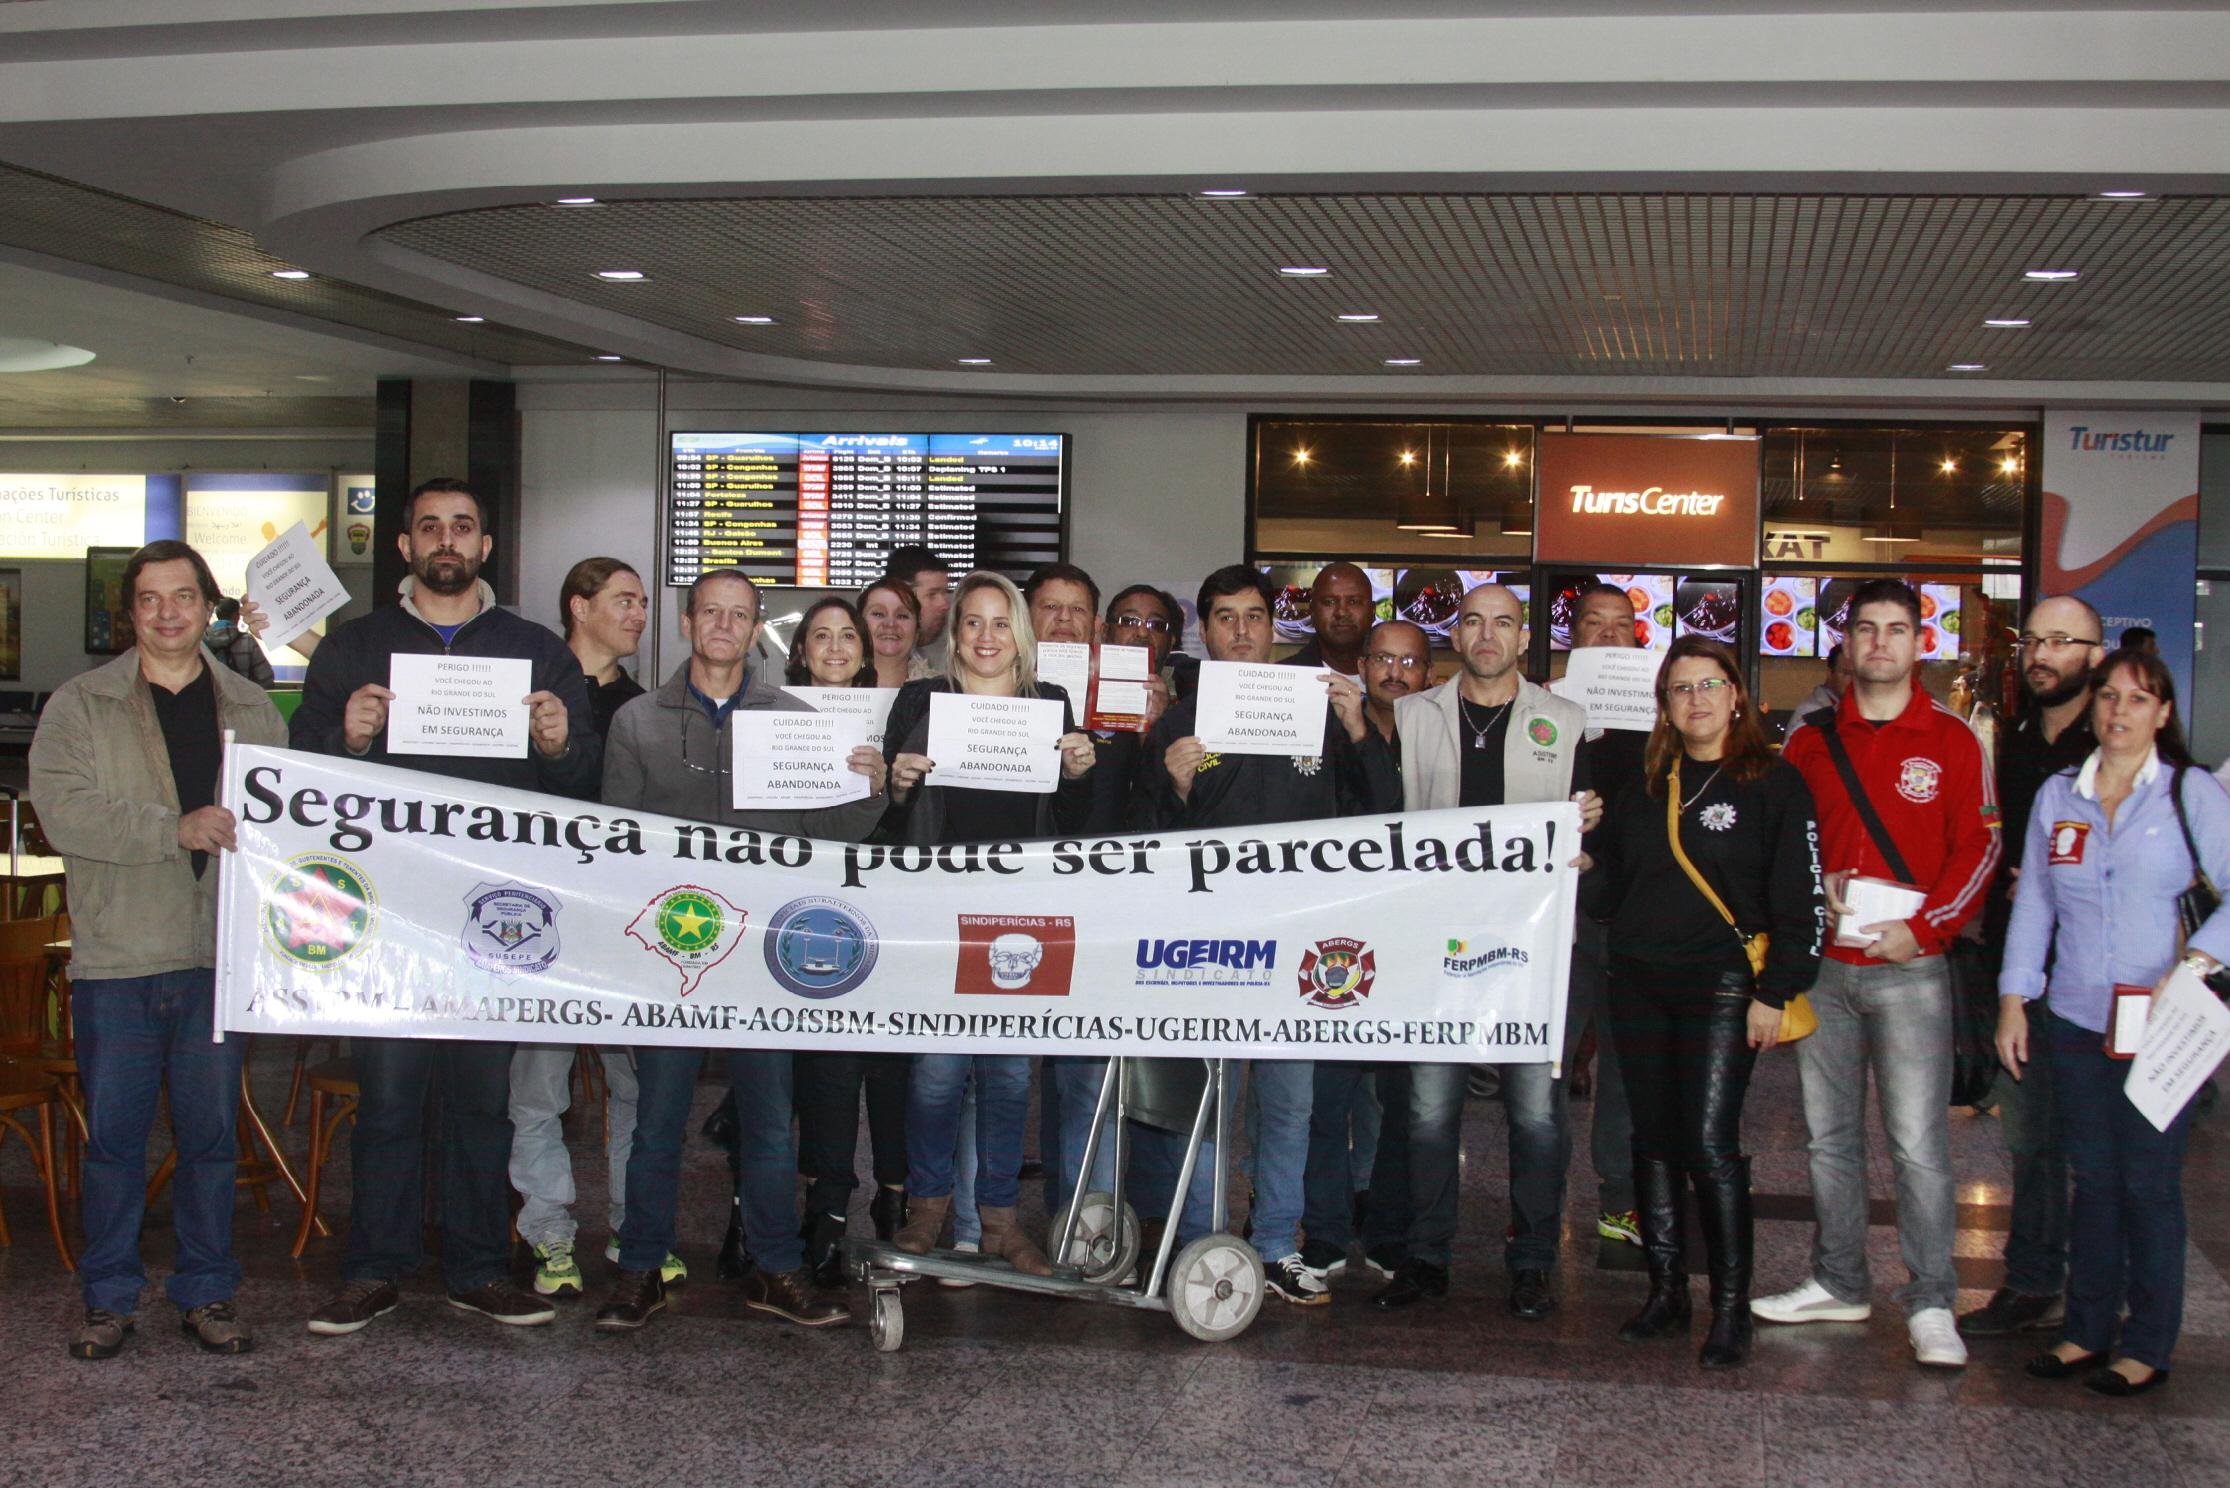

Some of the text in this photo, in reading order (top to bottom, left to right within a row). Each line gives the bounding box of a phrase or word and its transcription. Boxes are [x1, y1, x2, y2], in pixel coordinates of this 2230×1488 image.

[822, 435, 908, 446] Arrivals
[2070, 427, 2174, 451] Turistur
[0, 487, 120, 504] ações Turísticas
[1570, 485, 1724, 516] TurisCenter
[194, 533, 246, 544] Welcome
[256, 549, 279, 568] CUIDADO
[275, 576, 311, 605] SEGURANÇA
[283, 588, 325, 621] ABANDONADA
[438, 664, 469, 672] PERIGO
[1238, 669, 1275, 679] CUIDADO
[1587, 686, 1656, 698] NÃO INVESTIMO
[418, 704, 507, 718] NÃO INVESTIMOS
[971, 702, 1009, 712] CUIDADO
[1605, 704, 1657, 714] SEGURANÇA
[1234, 710, 1293, 722] SEGURANÇA
[773, 719, 812, 727] CUIDADO
[422, 725, 504, 738] EM SEGURANÇA
[1228, 728, 1297, 738] ABANDONADA
[967, 744, 1027, 757] SEGURANÇA
[773, 761, 834, 772] SEGURANÇA
[960, 762, 1031, 772] ABANDONADA
[1198, 759, 1221, 772] CIVIL
[767, 780, 841, 789] ABANDONADA
[242, 766, 646, 864] Segurança
[1052, 838, 1160, 875] ser
[1184, 820, 1557, 892] parcelada!
[960, 916, 1071, 927] SINDIPERÍCIAS RS
[1810, 906, 1825, 957] CIVIL
[308, 944, 326, 955] BM
[658, 942, 679, 956] ABAMF
[1323, 940, 1359, 949] ABERGS
[1136, 939, 1277, 969] UGEIRM
[1444, 947, 1528, 972] FERPMBM-RS
[1136, 970, 1272, 980] SINDICATO
